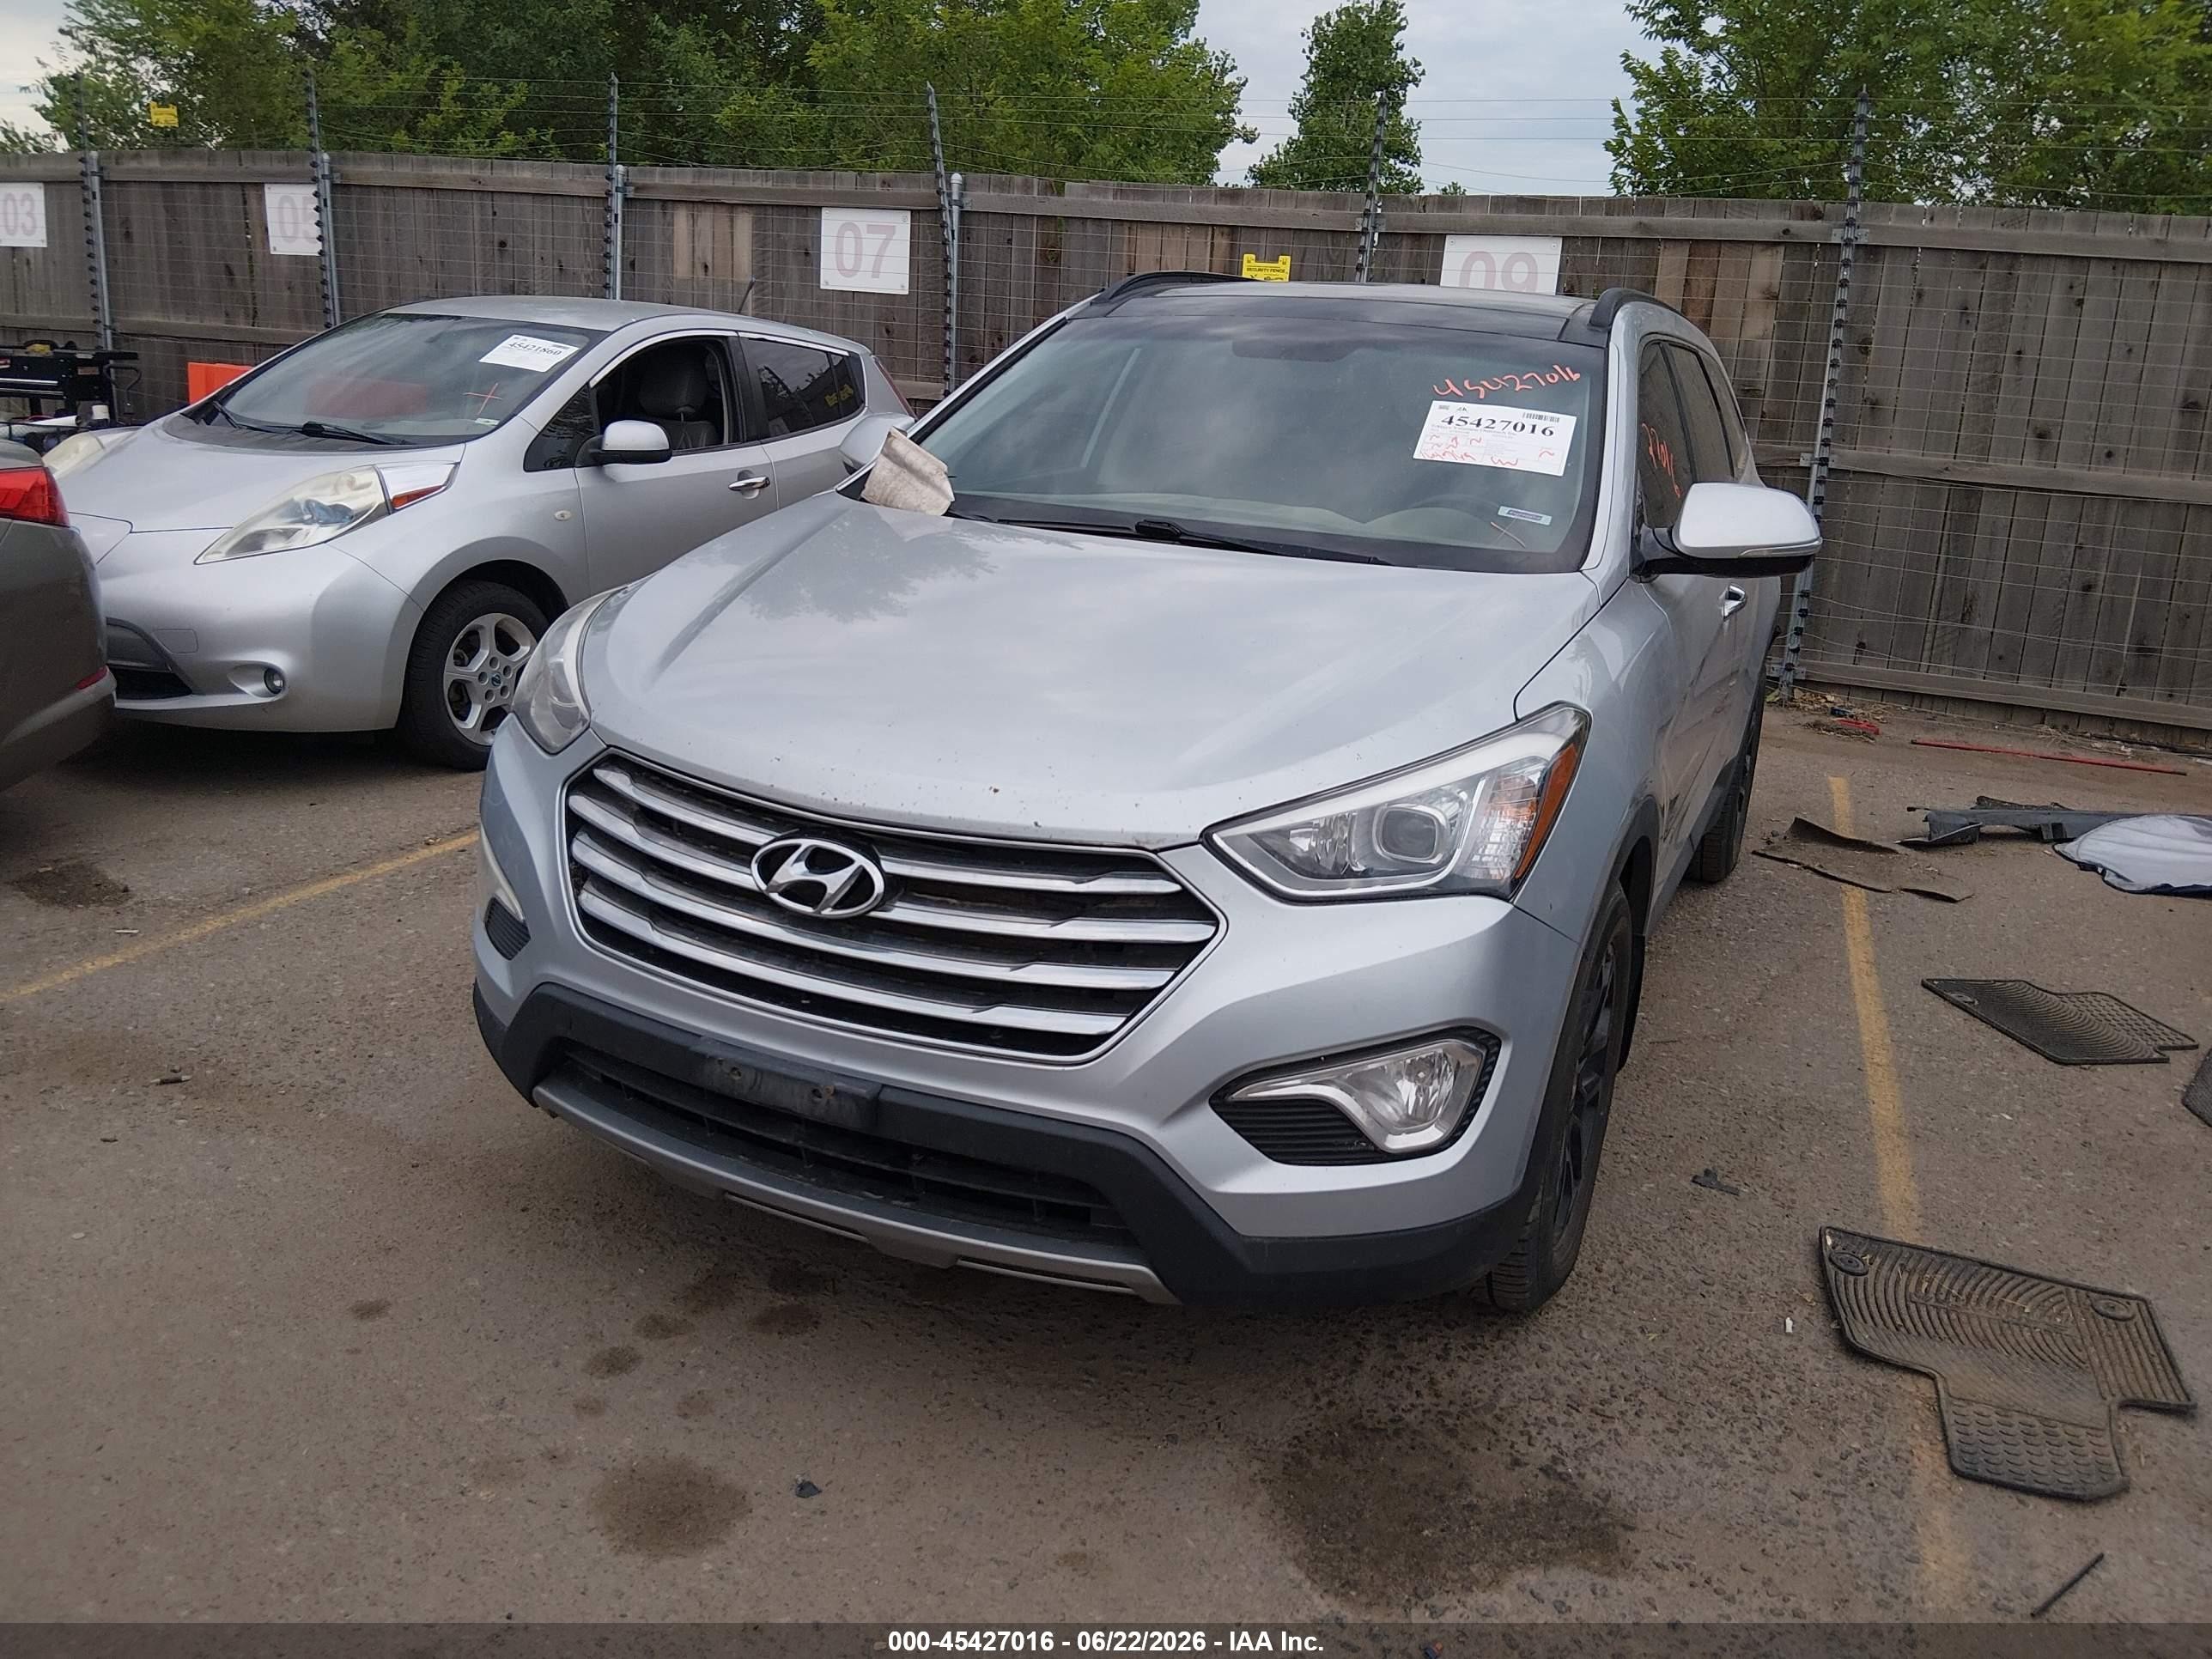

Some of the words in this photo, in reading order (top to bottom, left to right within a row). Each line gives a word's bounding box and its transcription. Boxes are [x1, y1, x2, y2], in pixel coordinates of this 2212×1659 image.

[4, 192, 36, 236] 03
[835, 222, 896, 279] 07
[508, 341, 562, 356] 45421860
[1441, 415, 1555, 437] 45427016
